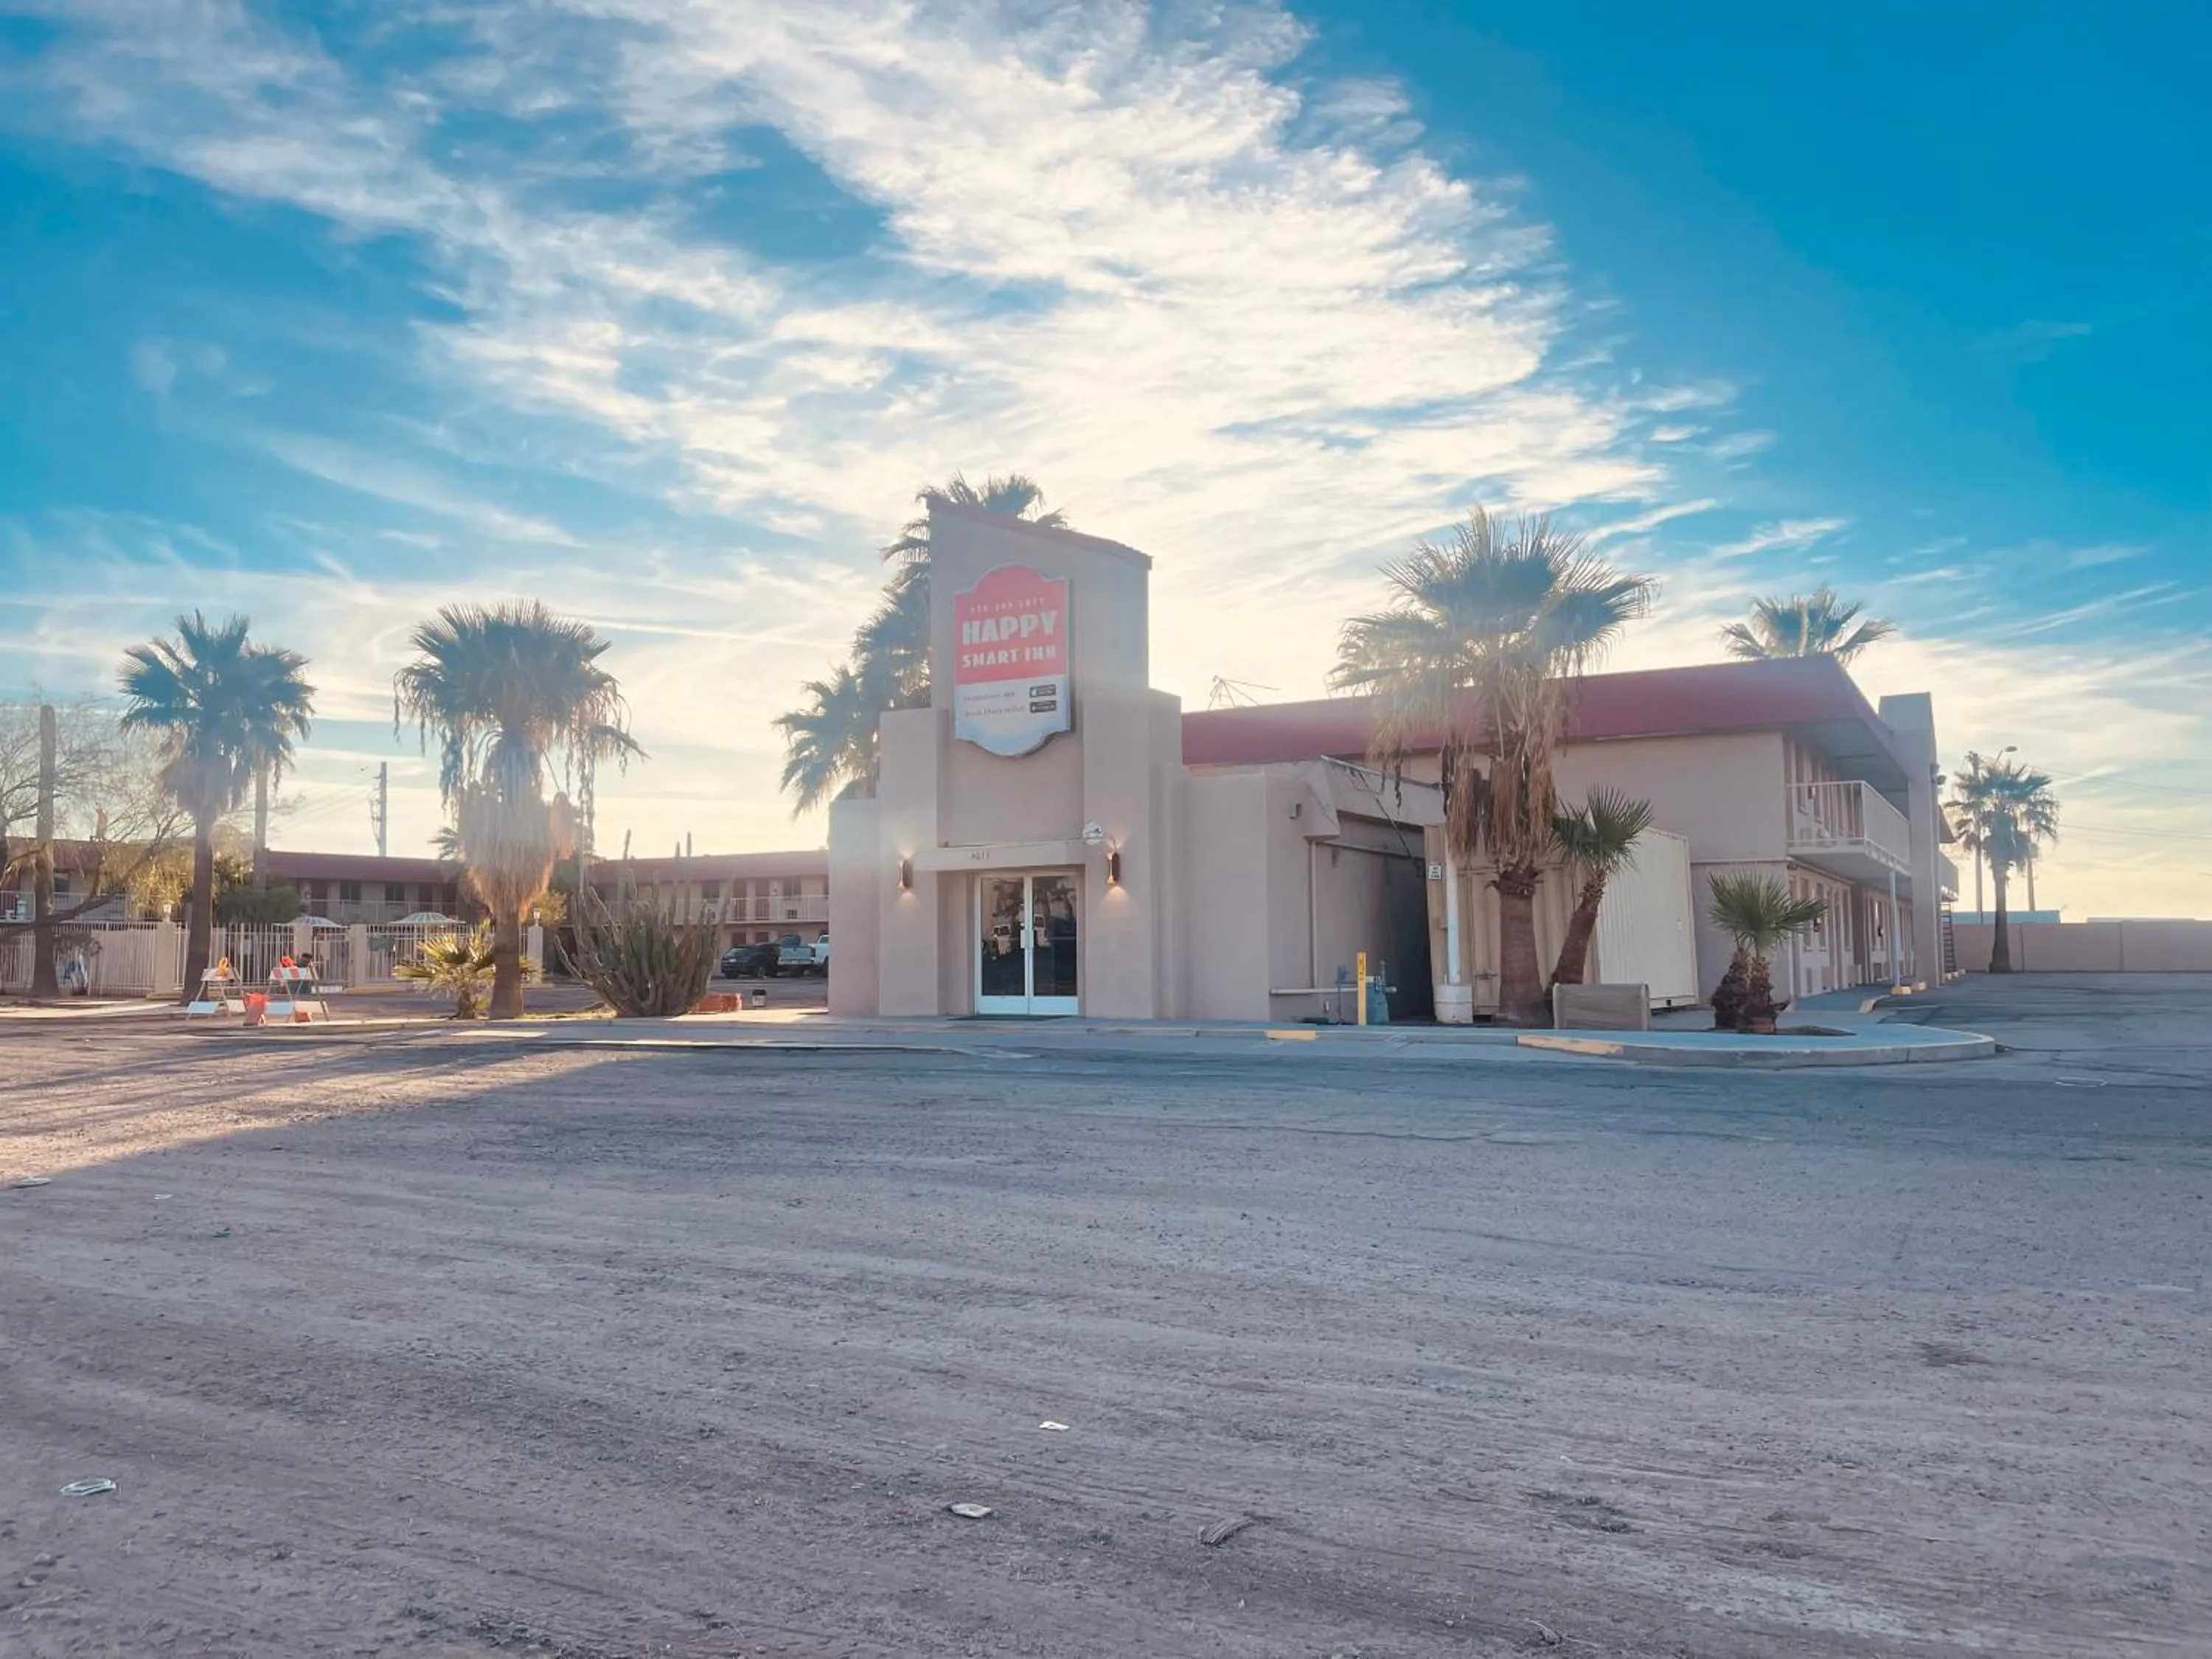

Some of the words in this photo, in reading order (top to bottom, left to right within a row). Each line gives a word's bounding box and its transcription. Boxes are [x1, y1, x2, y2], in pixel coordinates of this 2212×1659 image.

[962, 611, 1058, 645] HAPPY
[961, 649, 1020, 668] SMART
[1024, 644, 1057, 662] INN
